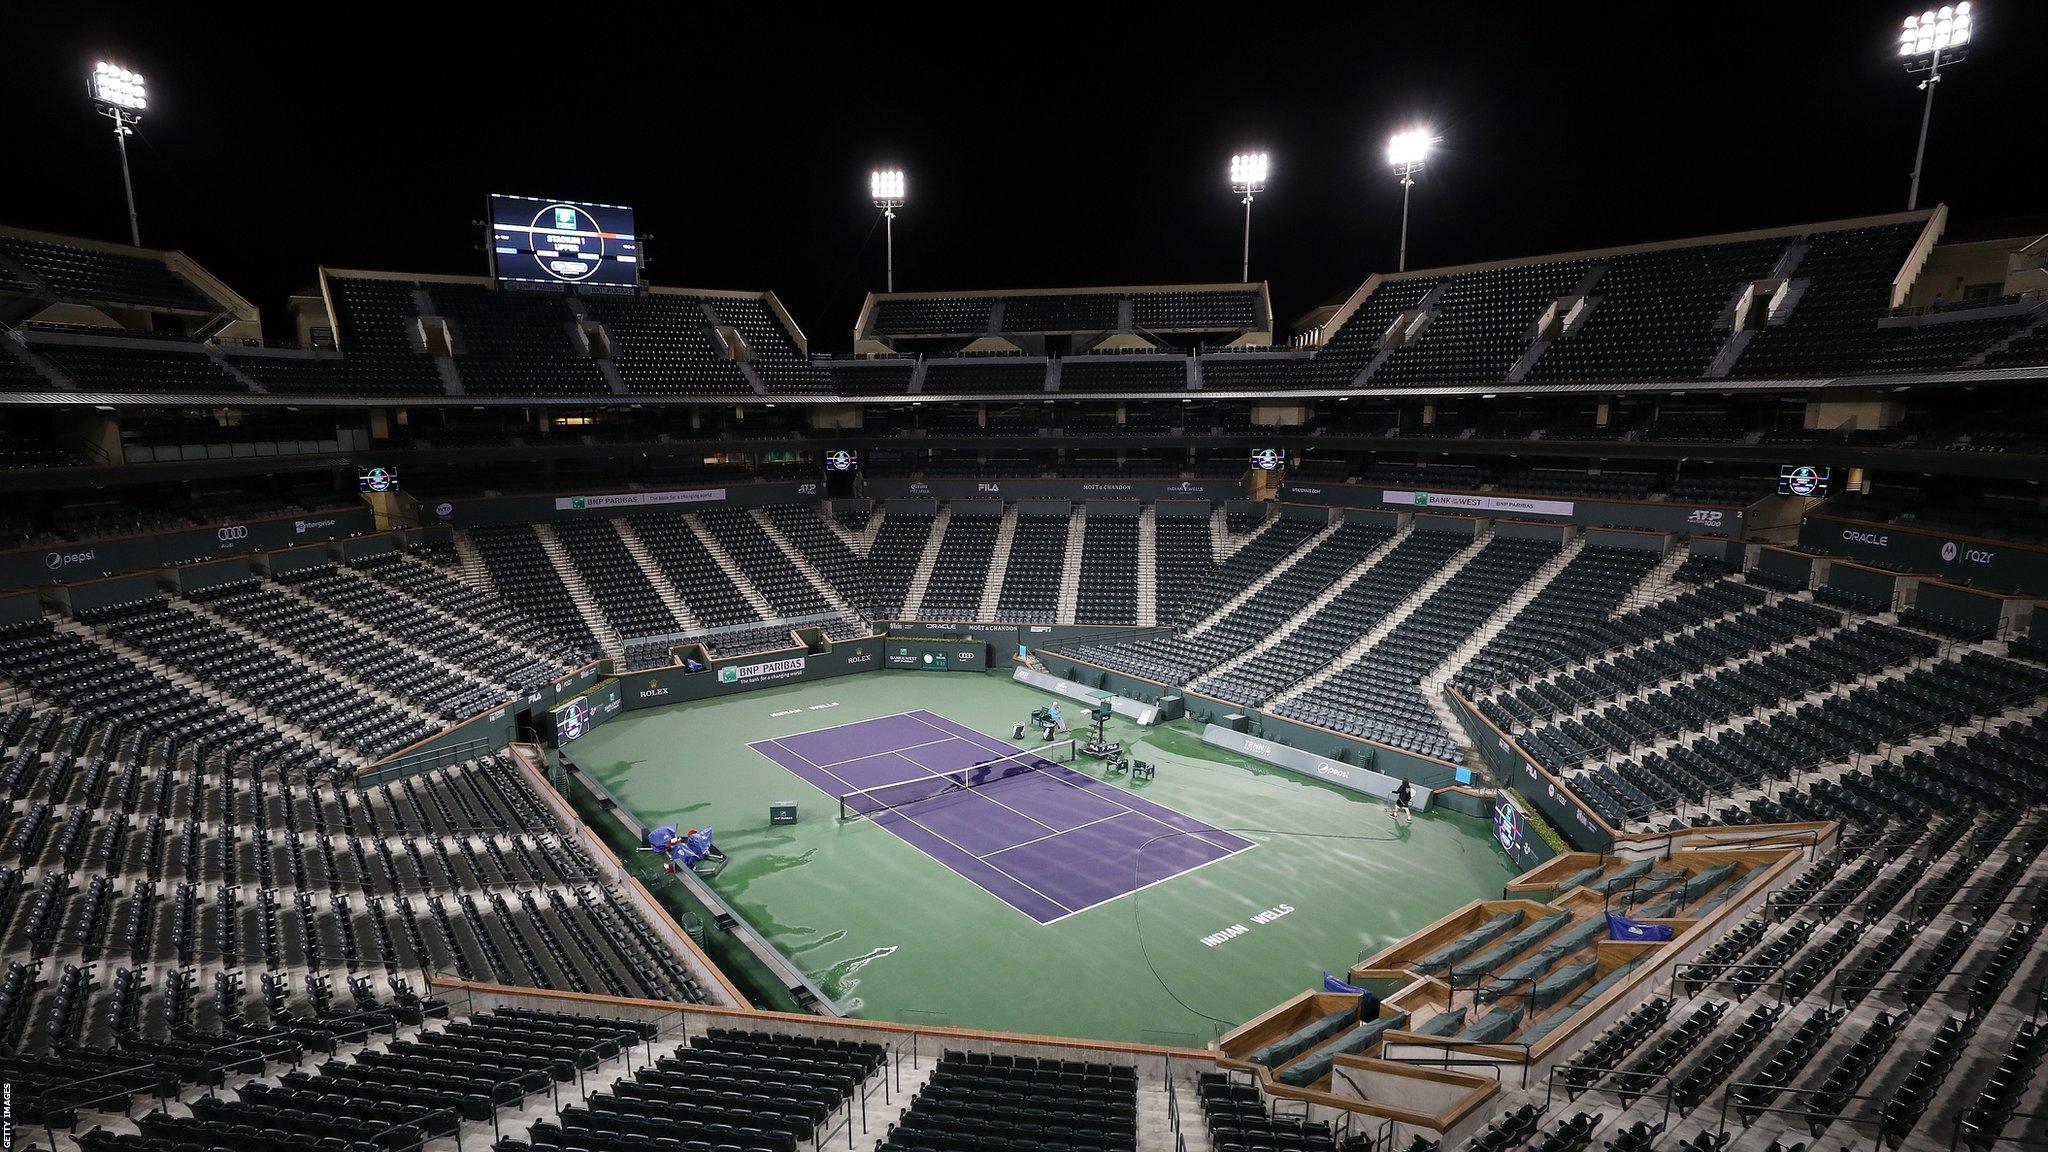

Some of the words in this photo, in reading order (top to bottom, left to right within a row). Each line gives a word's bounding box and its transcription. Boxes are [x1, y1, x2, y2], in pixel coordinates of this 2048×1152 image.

[978, 484, 999, 492] FILA
[605, 496, 638, 504] PARIBAS
[1688, 510, 1723, 521] ATP
[1842, 530, 1889, 547] ORACLE
[63, 550, 96, 566] pepsi
[1965, 549, 1995, 564] razr
[847, 654, 871, 664] ROLEX
[740, 665, 760, 677] BNP
[763, 660, 802, 673] PARIBAS
[528, 692, 542, 704] FILA
[640, 687, 669, 698] ROLEX
[1244, 740, 1272, 753] TENNIS
[1327, 767, 1350, 779] pepsi
[1200, 923, 1250, 947] INDIAN
[1250, 903, 1295, 925] WELLS
